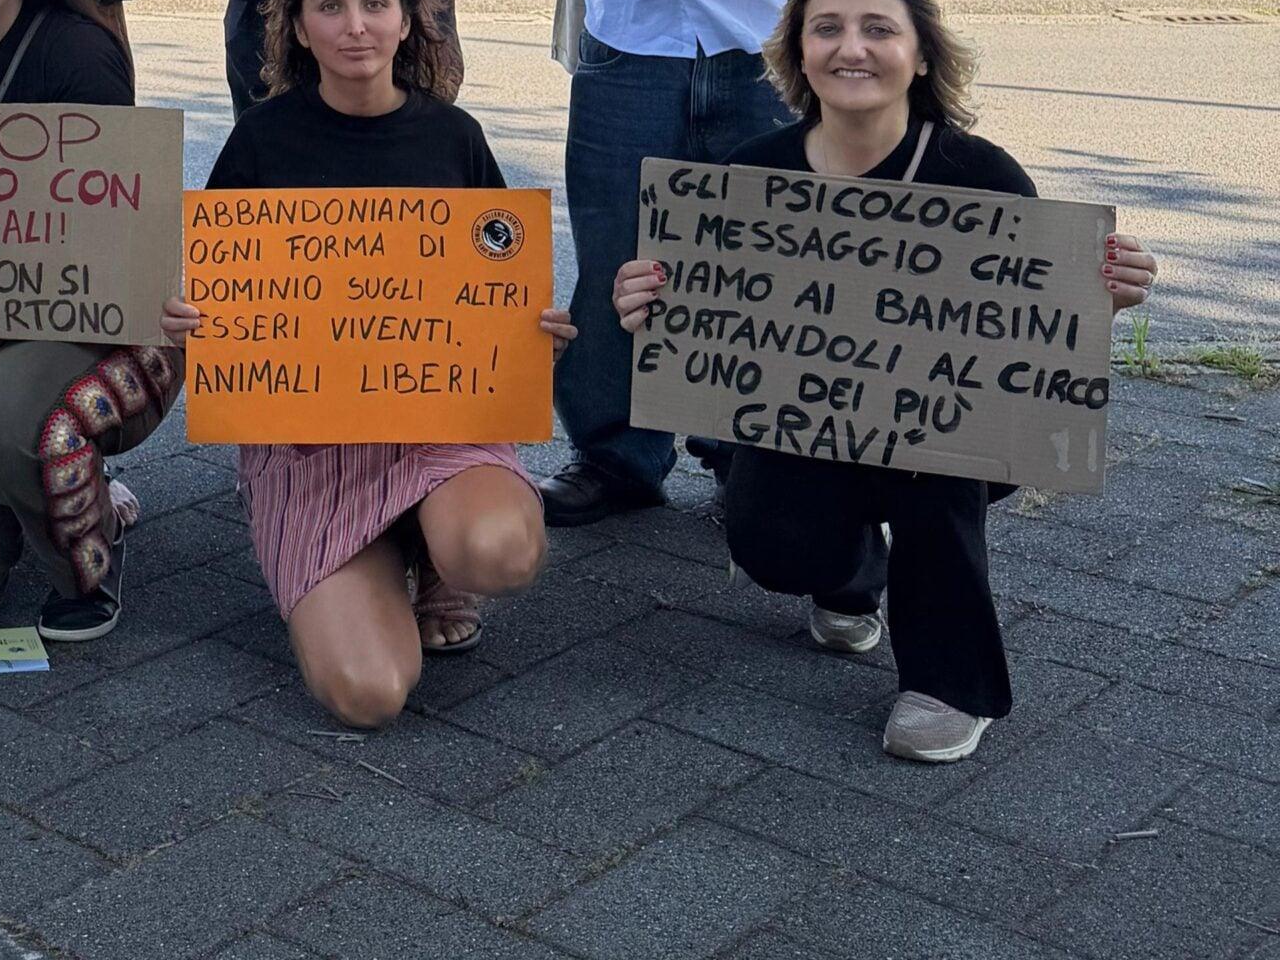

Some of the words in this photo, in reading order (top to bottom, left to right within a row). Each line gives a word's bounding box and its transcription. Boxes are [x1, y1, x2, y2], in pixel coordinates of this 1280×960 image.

[49, 168, 141, 211] CON
[191, 198, 452, 228] ABBANDONIAMO
[765, 174, 1022, 242] PSICOLOGI:
[190, 237, 261, 265] OGNI
[286, 232, 385, 262] FORMA
[420, 233, 445, 258] DI
[648, 207, 694, 243] IL
[695, 213, 943, 276] MESSAGGIO
[970, 254, 1054, 291] CHE
[58, 263, 90, 296] SI
[190, 274, 322, 304] DOMINIO
[347, 276, 423, 303] SUGLI
[454, 282, 529, 307] ALTRI
[190, 312, 300, 342] ESSERI
[330, 315, 462, 348] VIVENTI.
[794, 281, 836, 316] AI
[875, 287, 1079, 352] BAMBINI
[194, 359, 320, 396] ANIMALI
[359, 345, 498, 395] LIBERI!
[644, 299, 902, 374] PORTANDOLI
[928, 352, 984, 390] AL
[997, 361, 1110, 411] CIRCO
[685, 349, 762, 396] UNO
[798, 371, 865, 412] DEI
[894, 388, 974, 434] PIÙ
